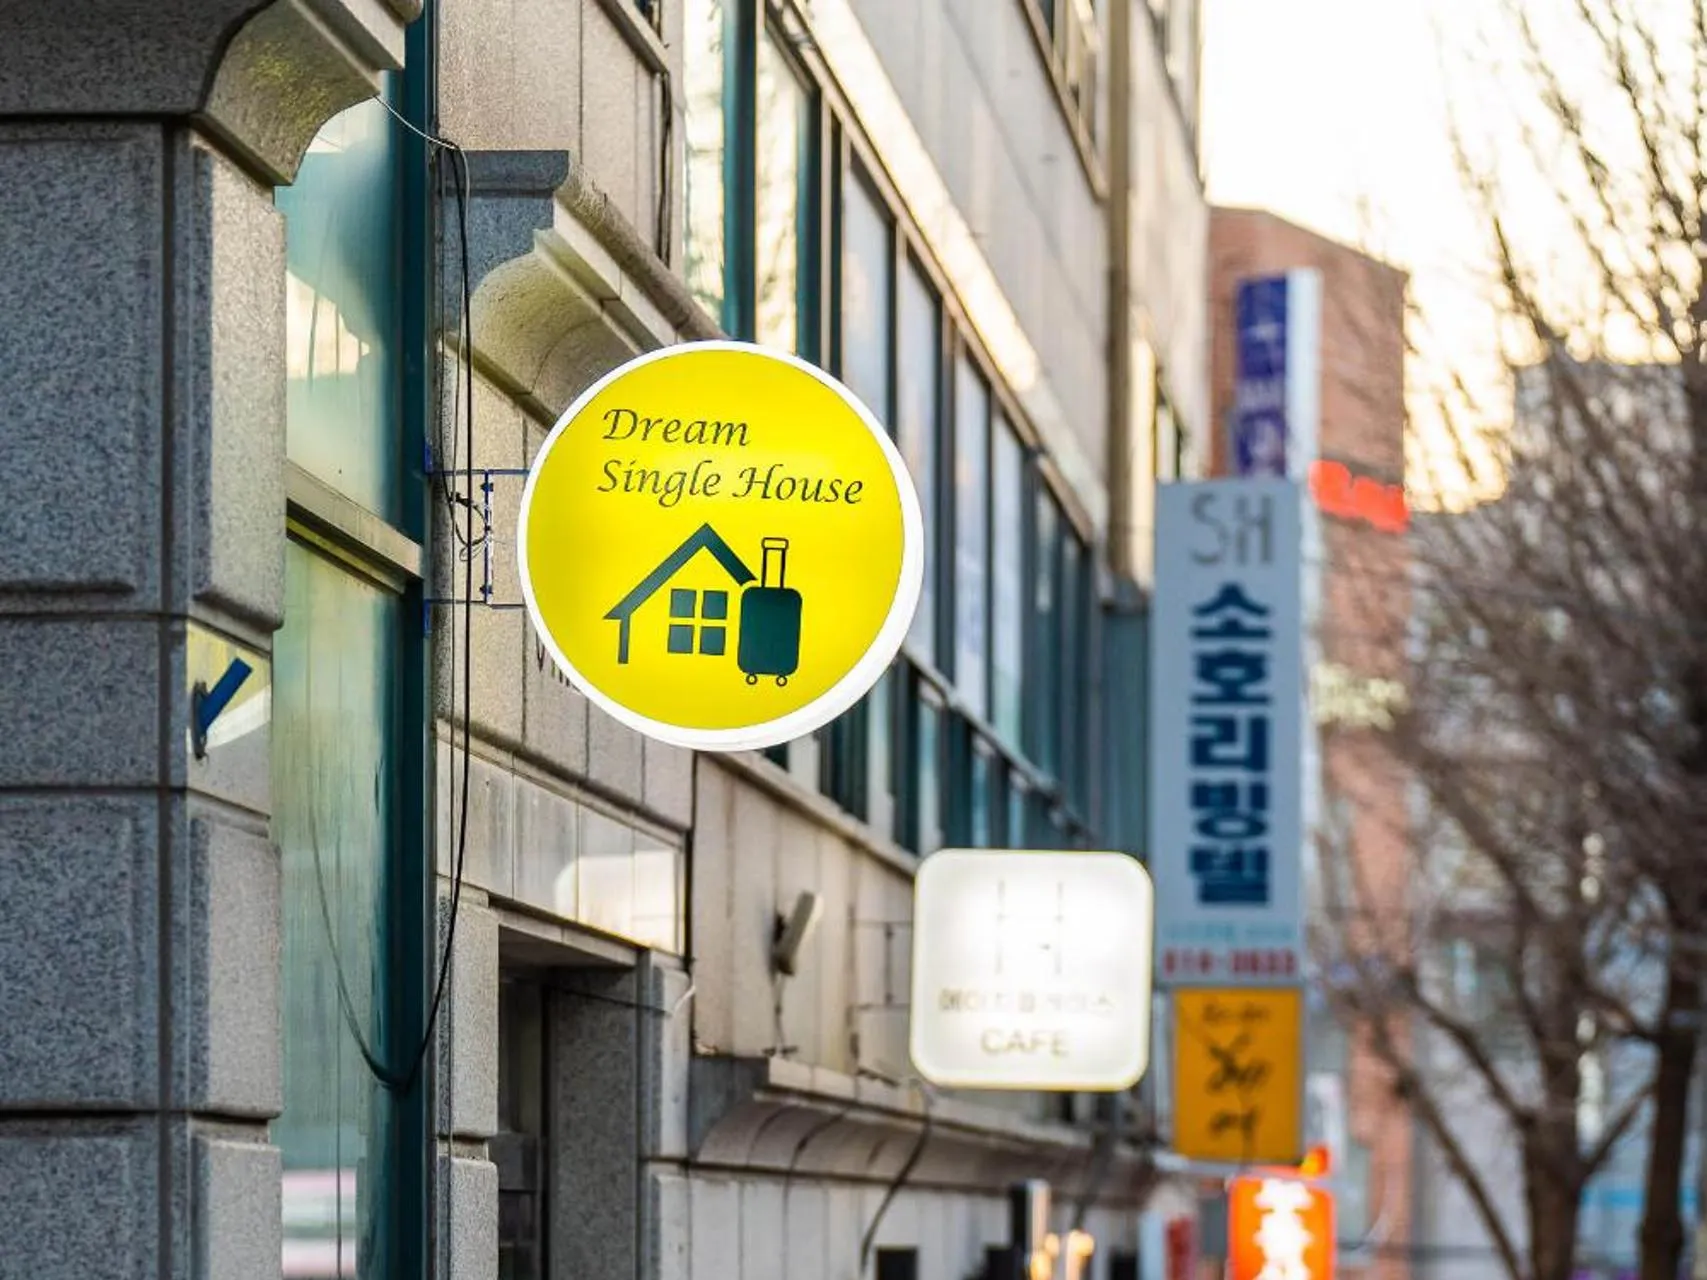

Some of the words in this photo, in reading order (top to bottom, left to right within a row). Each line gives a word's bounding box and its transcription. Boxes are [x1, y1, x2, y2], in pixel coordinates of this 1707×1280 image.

[602, 407, 750, 447] Dream
[597, 458, 722, 508] Single
[732, 463, 864, 505] House
[1189, 491, 1274, 567] SH
[1187, 580, 1274, 907] 소호리빙텔
[979, 1027, 1072, 1059] CAFE
